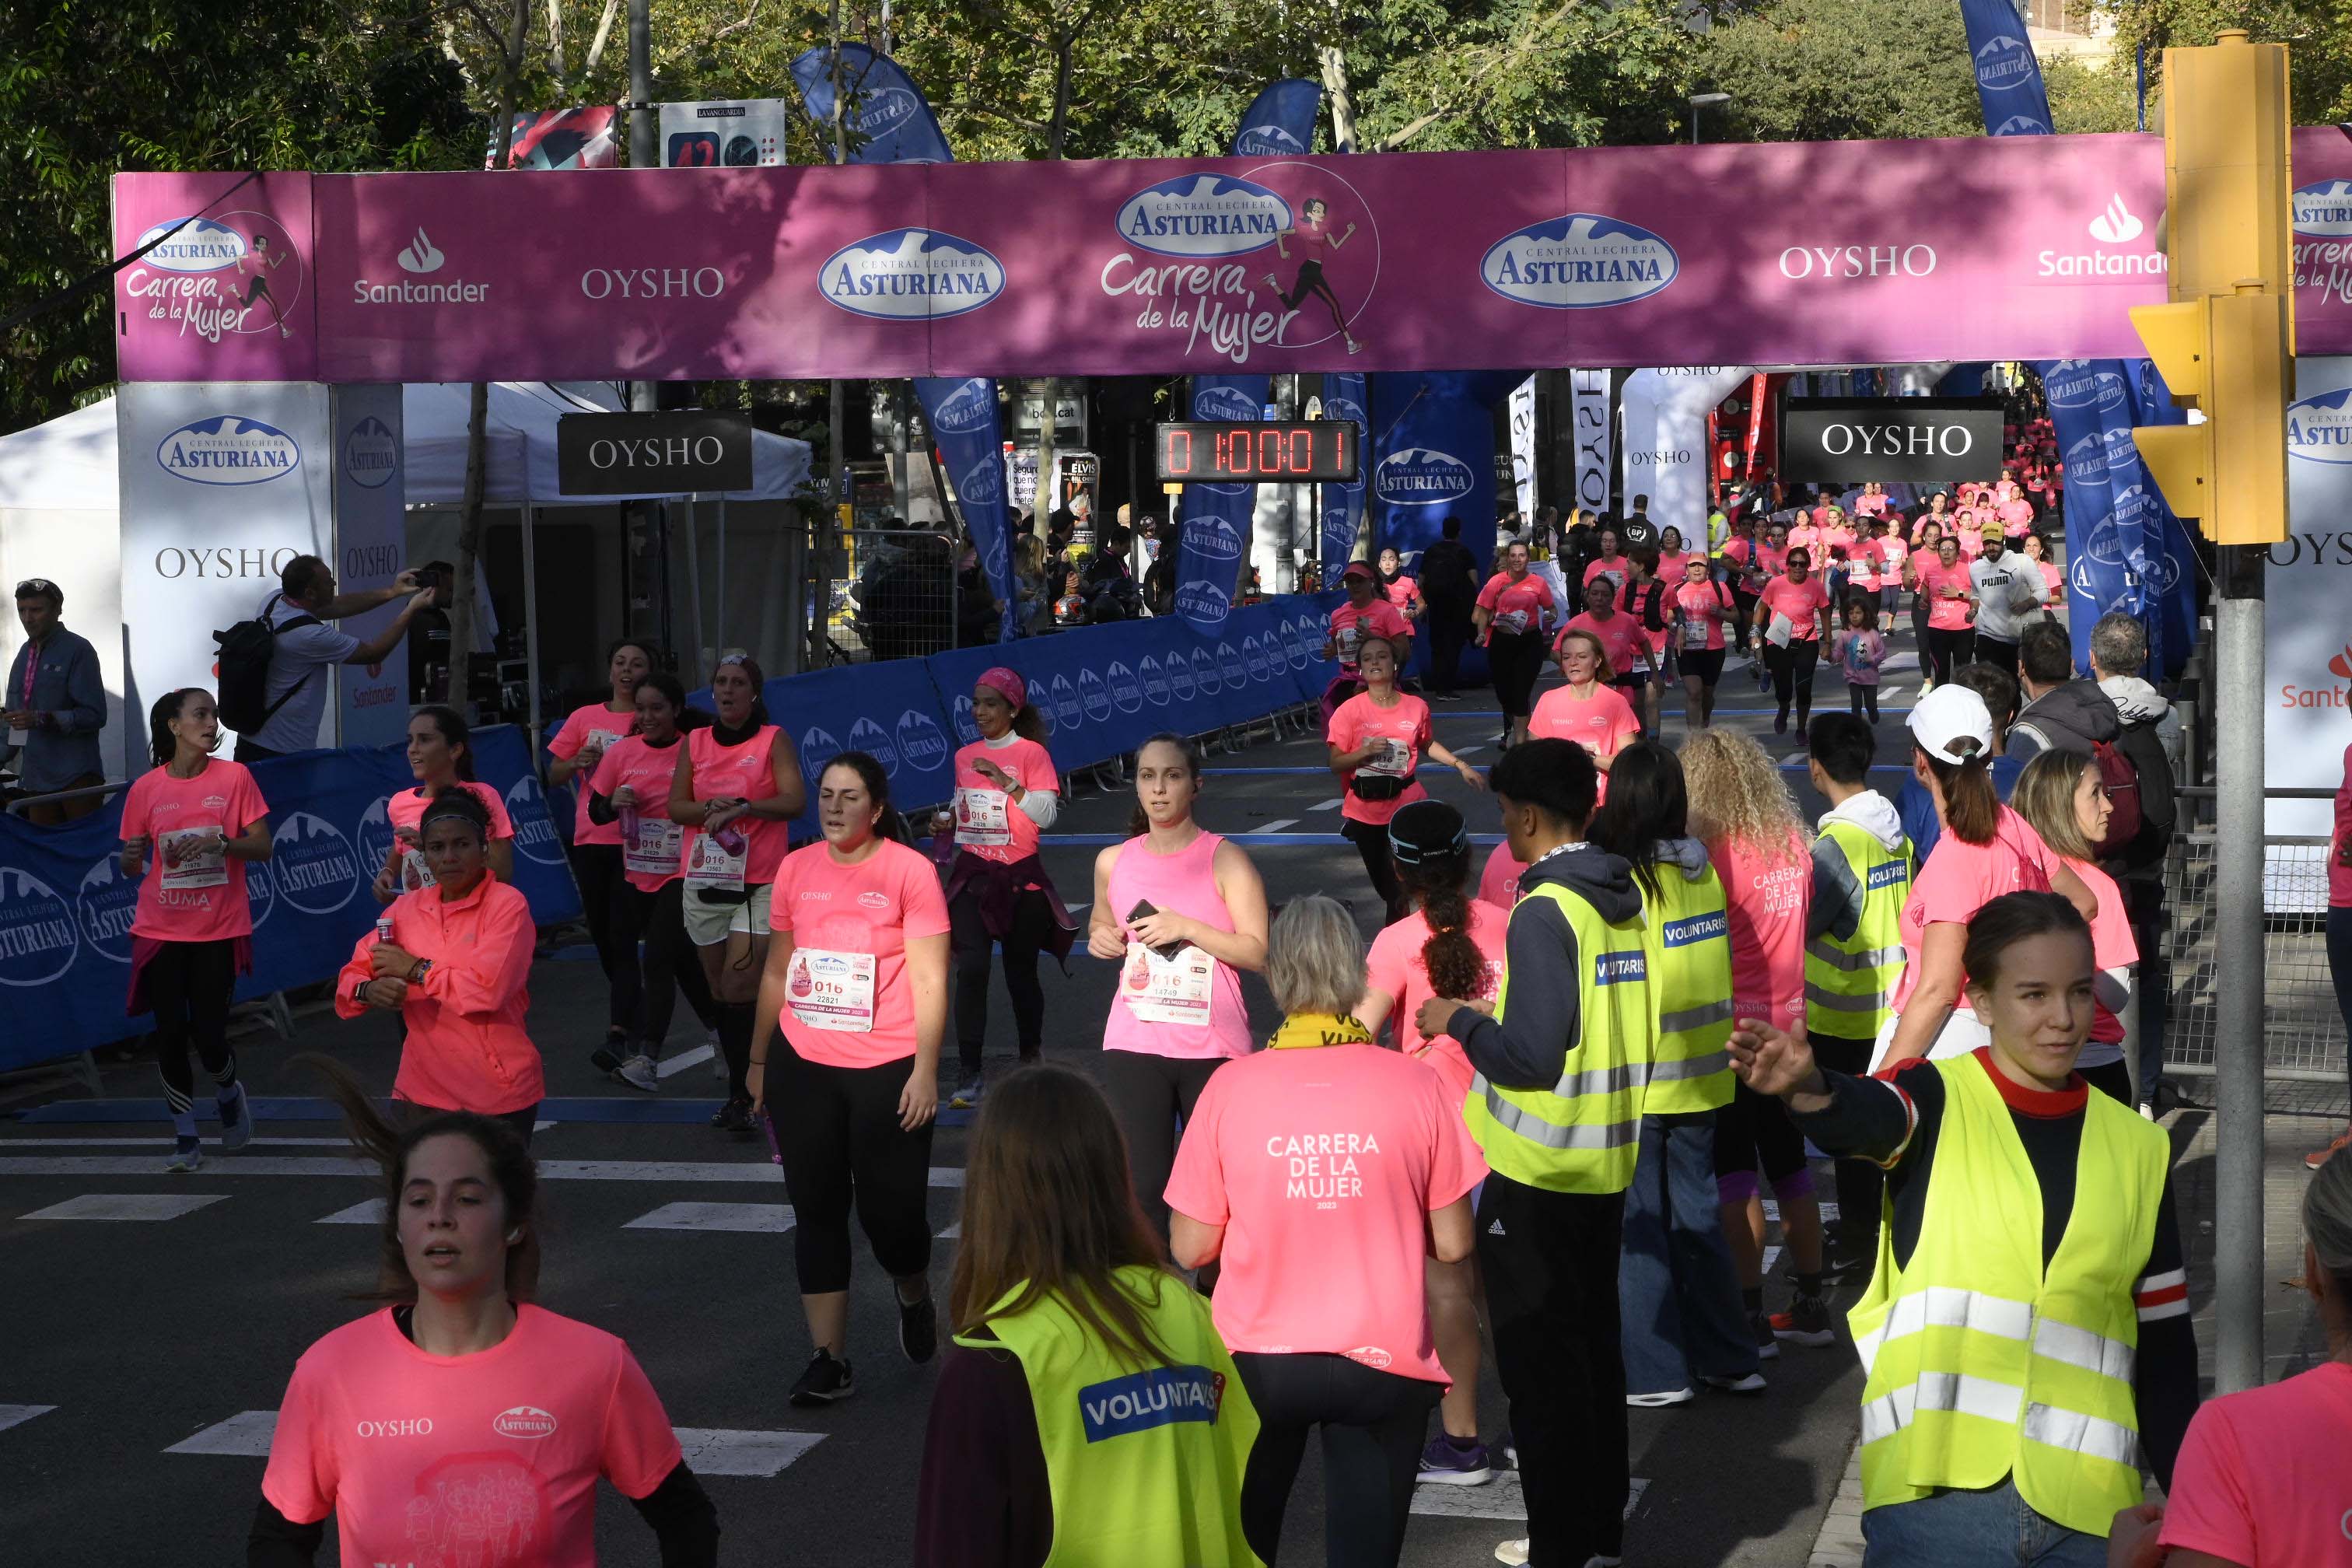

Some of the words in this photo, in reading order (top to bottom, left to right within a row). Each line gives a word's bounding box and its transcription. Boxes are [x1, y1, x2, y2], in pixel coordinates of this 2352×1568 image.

[1157, 202, 1213, 212] CENTRAL
[1218, 201, 1274, 210] LECHERA
[1129, 206, 1279, 237] ASTURIANA
[202, 235, 236, 243] LECHERA
[144, 241, 238, 260] ASTURIANA
[1526, 247, 1587, 257] CENTRAL
[1594, 245, 1657, 254] LECHERA
[1779, 244, 1937, 278] OYSHO
[861, 260, 919, 269] CENTRAL
[925, 259, 985, 268] LECHERA
[1495, 250, 1663, 285] ASTURIANA
[2039, 251, 2168, 276] Santand
[126, 270, 217, 298] Carrera
[581, 267, 724, 299] OYSHO
[832, 263, 991, 297] ASTURIANA
[1101, 254, 1245, 296] Carrera
[2310, 270, 2324, 288] la
[354, 279, 490, 304] Santander
[149, 303, 166, 320] de
[169, 303, 182, 320] la
[180, 296, 253, 343] Mujer
[1136, 299, 1164, 328] de
[1170, 299, 1189, 329] la
[1185, 292, 1300, 363] Mujer
[239, 439, 285, 448] LECHERA
[1821, 424, 1973, 457] OYSHO
[168, 441, 290, 468] ASTURIANA
[588, 436, 724, 469] OYSHO
[1631, 450, 1691, 466] OYSHO
[1071, 463, 1096, 474] ELVIS
[1013, 476, 1026, 485] que
[1378, 470, 1467, 492] ASTURIANA
[1182, 525, 1239, 555] ASTURIANA
[2265, 531, 2352, 567] OYS
[156, 547, 299, 579] OYSHO
[347, 546, 398, 579] OYSHO
[1981, 575, 2009, 588] PUMA
[353, 686, 397, 710] Santander
[2281, 684, 2350, 709] Sant
[971, 811, 988, 821] 016
[642, 838, 662, 849] 016
[705, 856, 725, 865] 016
[278, 854, 355, 894] ASTURIANA
[1753, 866, 1805, 890] CARRERA
[157, 891, 210, 907] SUMA
[801, 891, 831, 901] OYSHO
[1765, 885, 1781, 901] DE
[1783, 880, 1797, 894] LA
[1763, 894, 1801, 915] MUJER
[0, 918, 75, 961] STURIANA
[1665, 916, 1727, 942] VOLUNTARIS
[814, 963, 847, 973] ASTURIANA
[814, 981, 844, 995] 016
[1153, 974, 1181, 986] 016
[794, 1003, 817, 1011] CARRERA
[817, 995, 839, 1005] 22821
[1266, 1133, 1380, 1157] CARRERA
[1290, 1157, 1319, 1178] DE
[1329, 1157, 1358, 1177] LA
[1286, 1178, 1363, 1199] MUJER
[1317, 1202, 1337, 1210] 2023
[1086, 1381, 1216, 1426] VOLUNTAS
[357, 1418, 434, 1438] OYSHO
[499, 1417, 552, 1433] ASTURIANA
